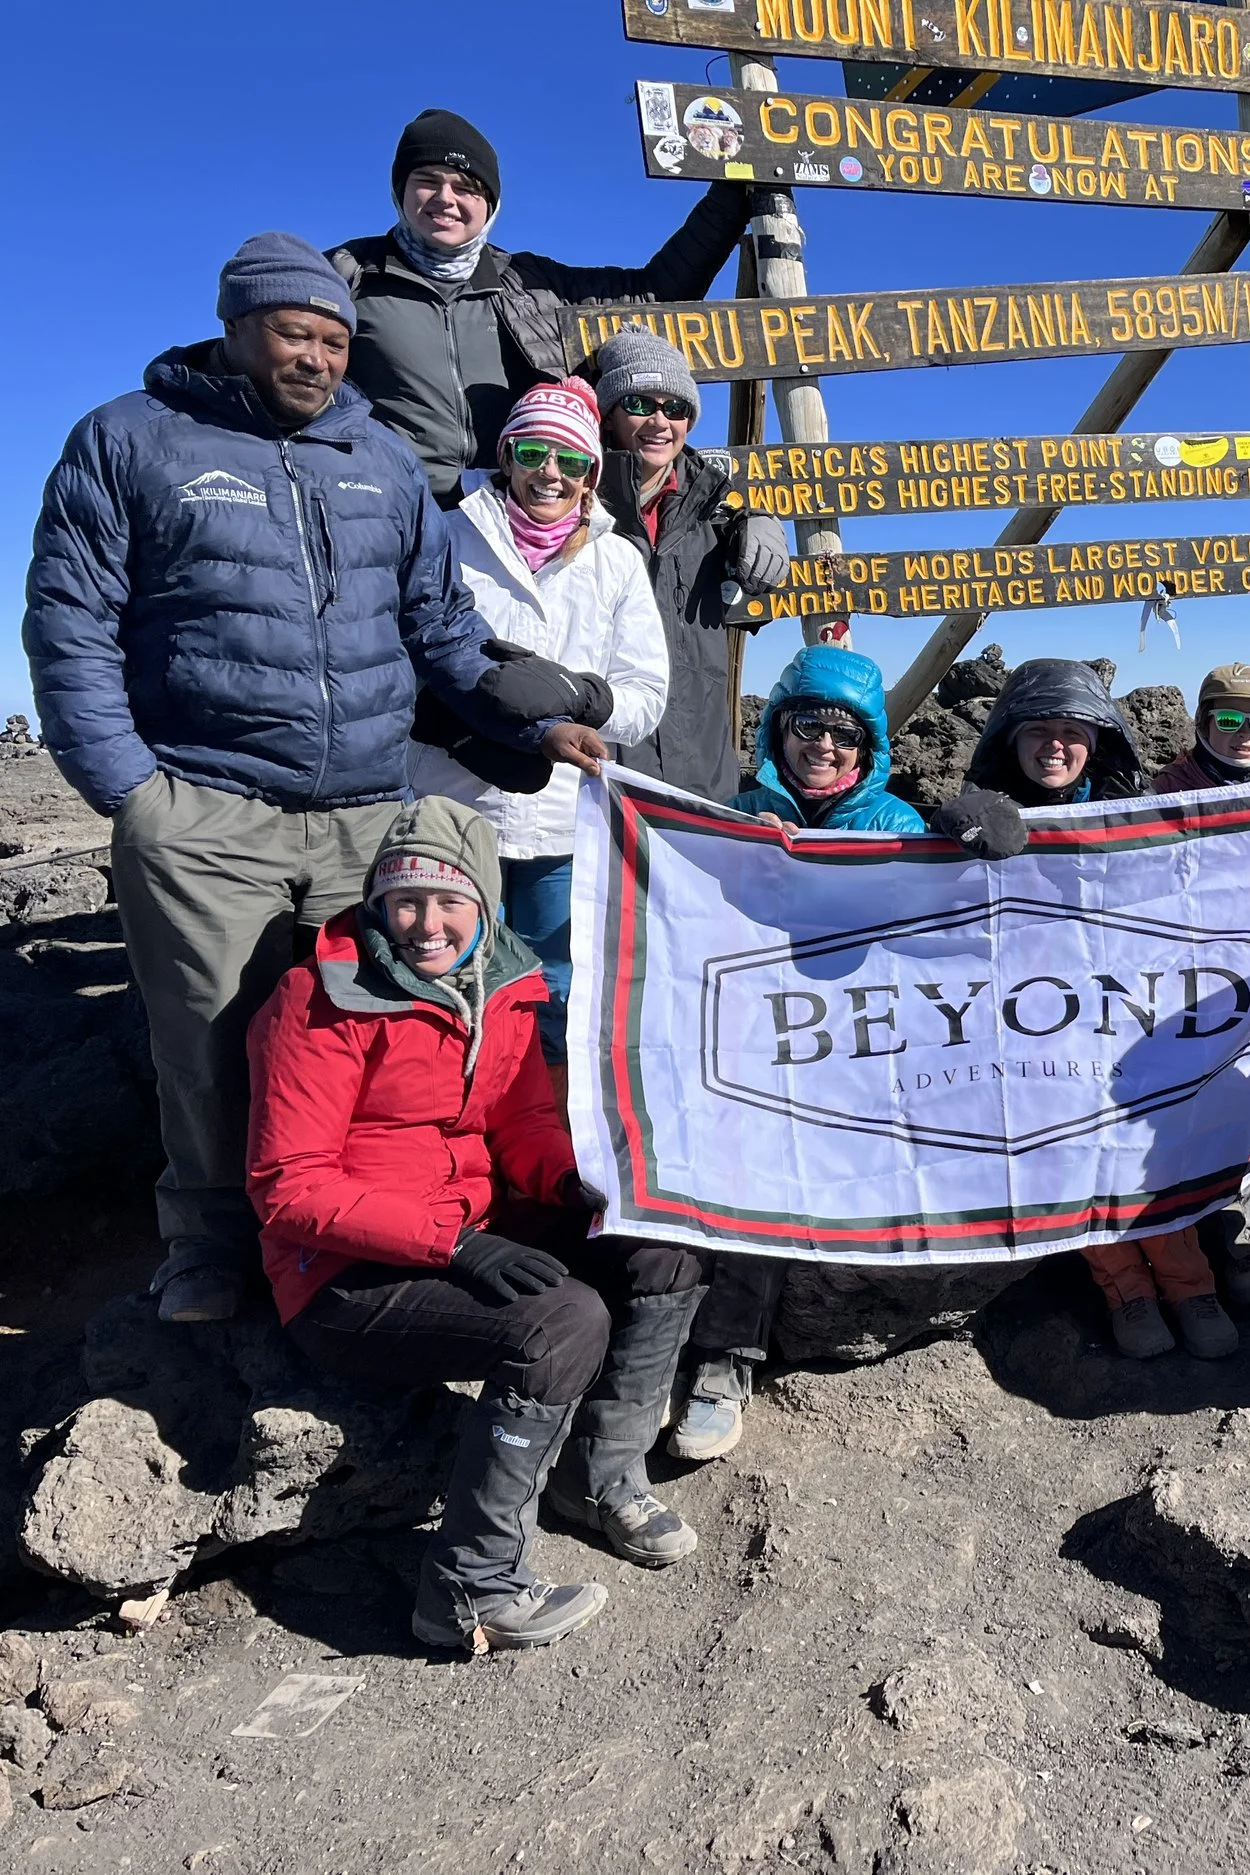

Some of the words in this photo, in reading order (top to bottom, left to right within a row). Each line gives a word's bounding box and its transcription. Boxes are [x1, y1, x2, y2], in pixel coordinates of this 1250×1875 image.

[955, 0, 1240, 79] KILIMANJARO
[877, 154, 943, 184] YOU
[964, 161, 1026, 192] ARE
[1052, 164, 1127, 200] NOW
[1145, 173, 1179, 202] AT
[760, 301, 891, 366] PEAK,
[512, 392, 599, 431] LABAM
[747, 446, 889, 480] AFRICA'S
[899, 439, 1029, 474] HIGHEST
[1041, 437, 1124, 469] POINT
[347, 481, 382, 494] Columbia
[748, 480, 886, 515] WORLD'S
[897, 473, 1029, 508] HIGHEST
[1037, 466, 1239, 502] FREE-STANDING
[776, 559, 833, 588] NE
[849, 557, 889, 584] OF
[904, 550, 1035, 581] WORLD'S
[1048, 542, 1178, 574] LARGEST
[899, 578, 1045, 612] HERITAGE
[1056, 574, 1104, 602] AND
[892, 1060, 1123, 1094] ADVENTURES
